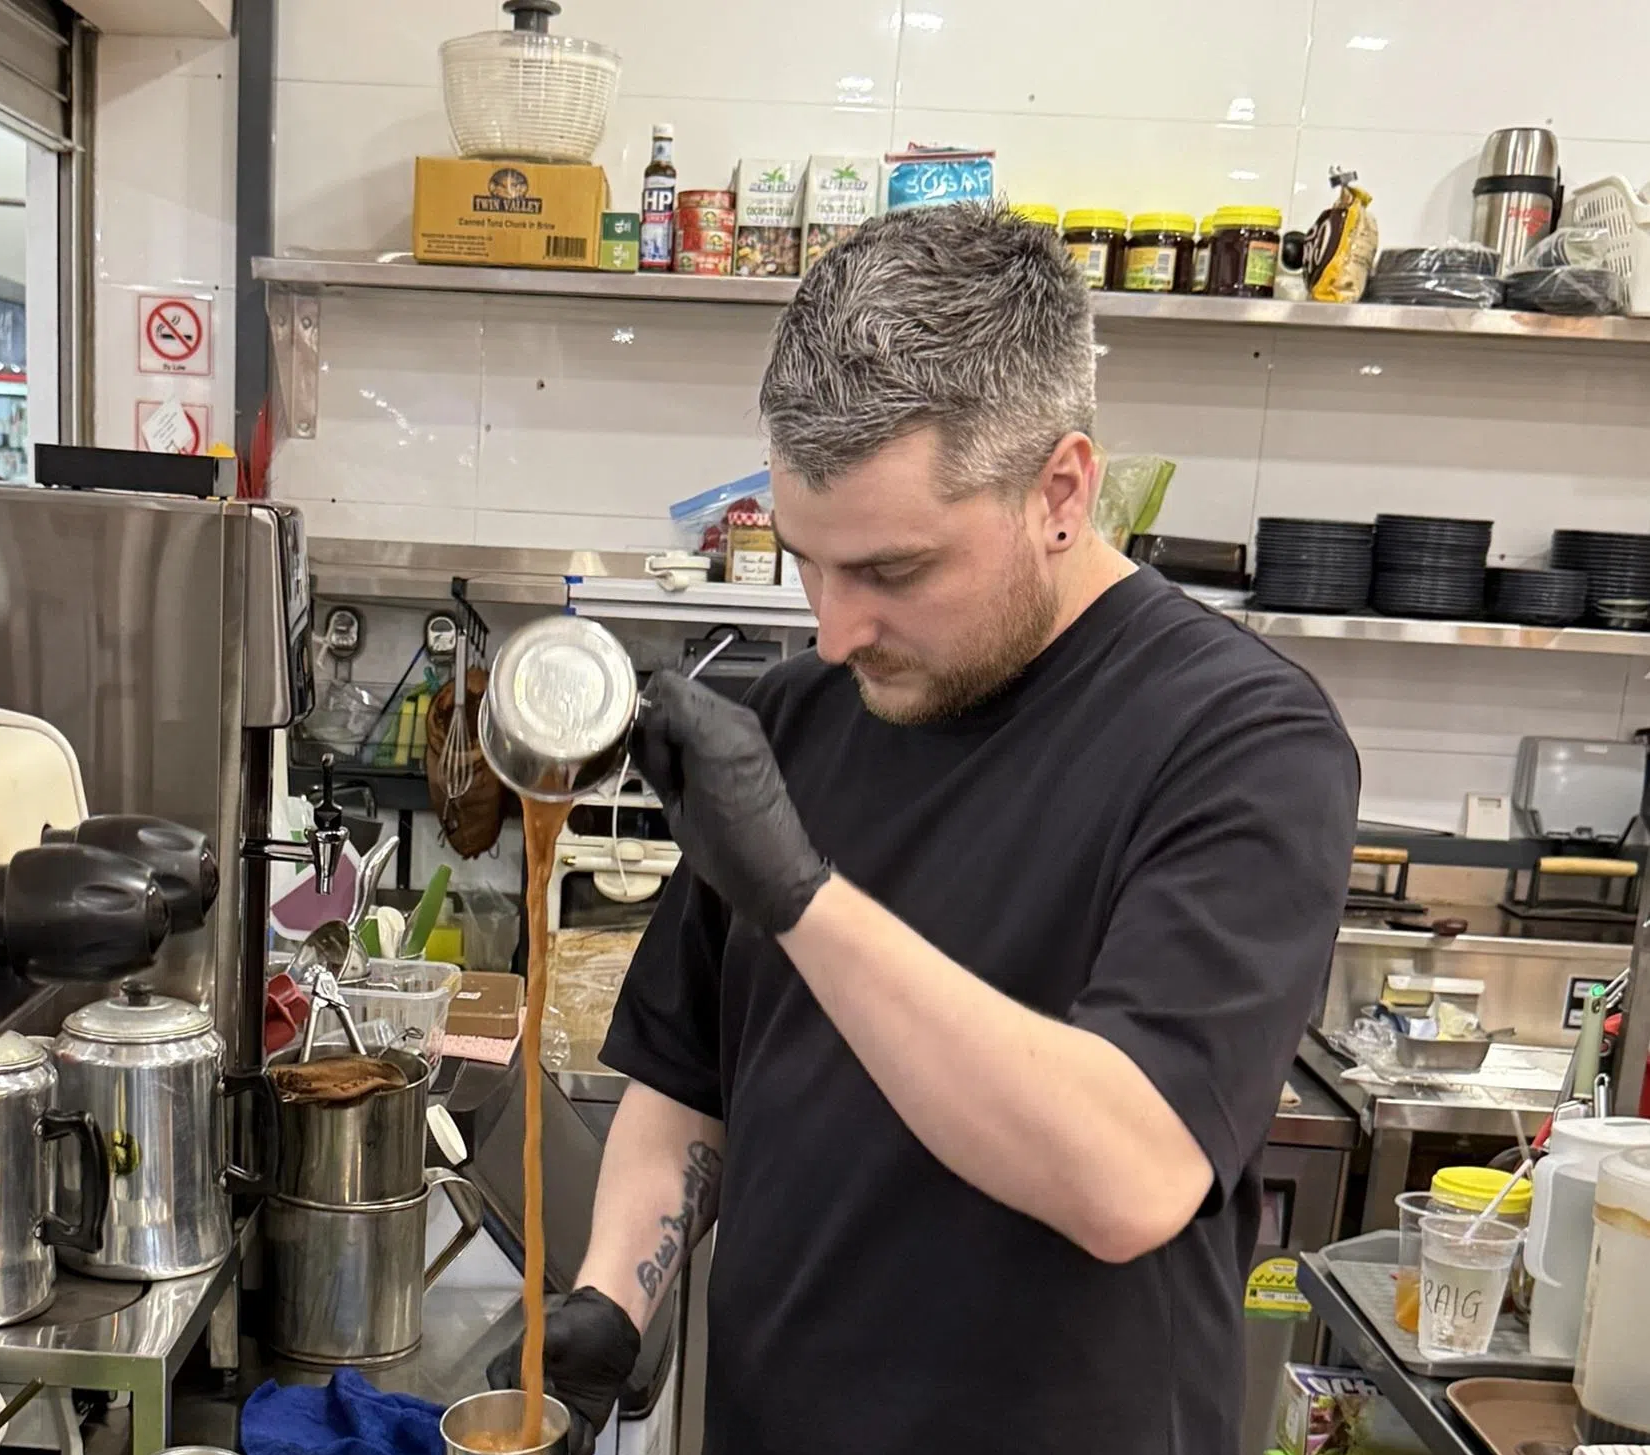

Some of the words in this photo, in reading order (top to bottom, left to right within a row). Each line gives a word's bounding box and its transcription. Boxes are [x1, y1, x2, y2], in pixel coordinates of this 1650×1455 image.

[475, 198, 500, 211] TWIN
[503, 199, 541, 213] VALLEY
[644, 190, 673, 212] HP
[458, 217, 485, 227] Canned
[1424, 1276, 1483, 1324] RAIG
